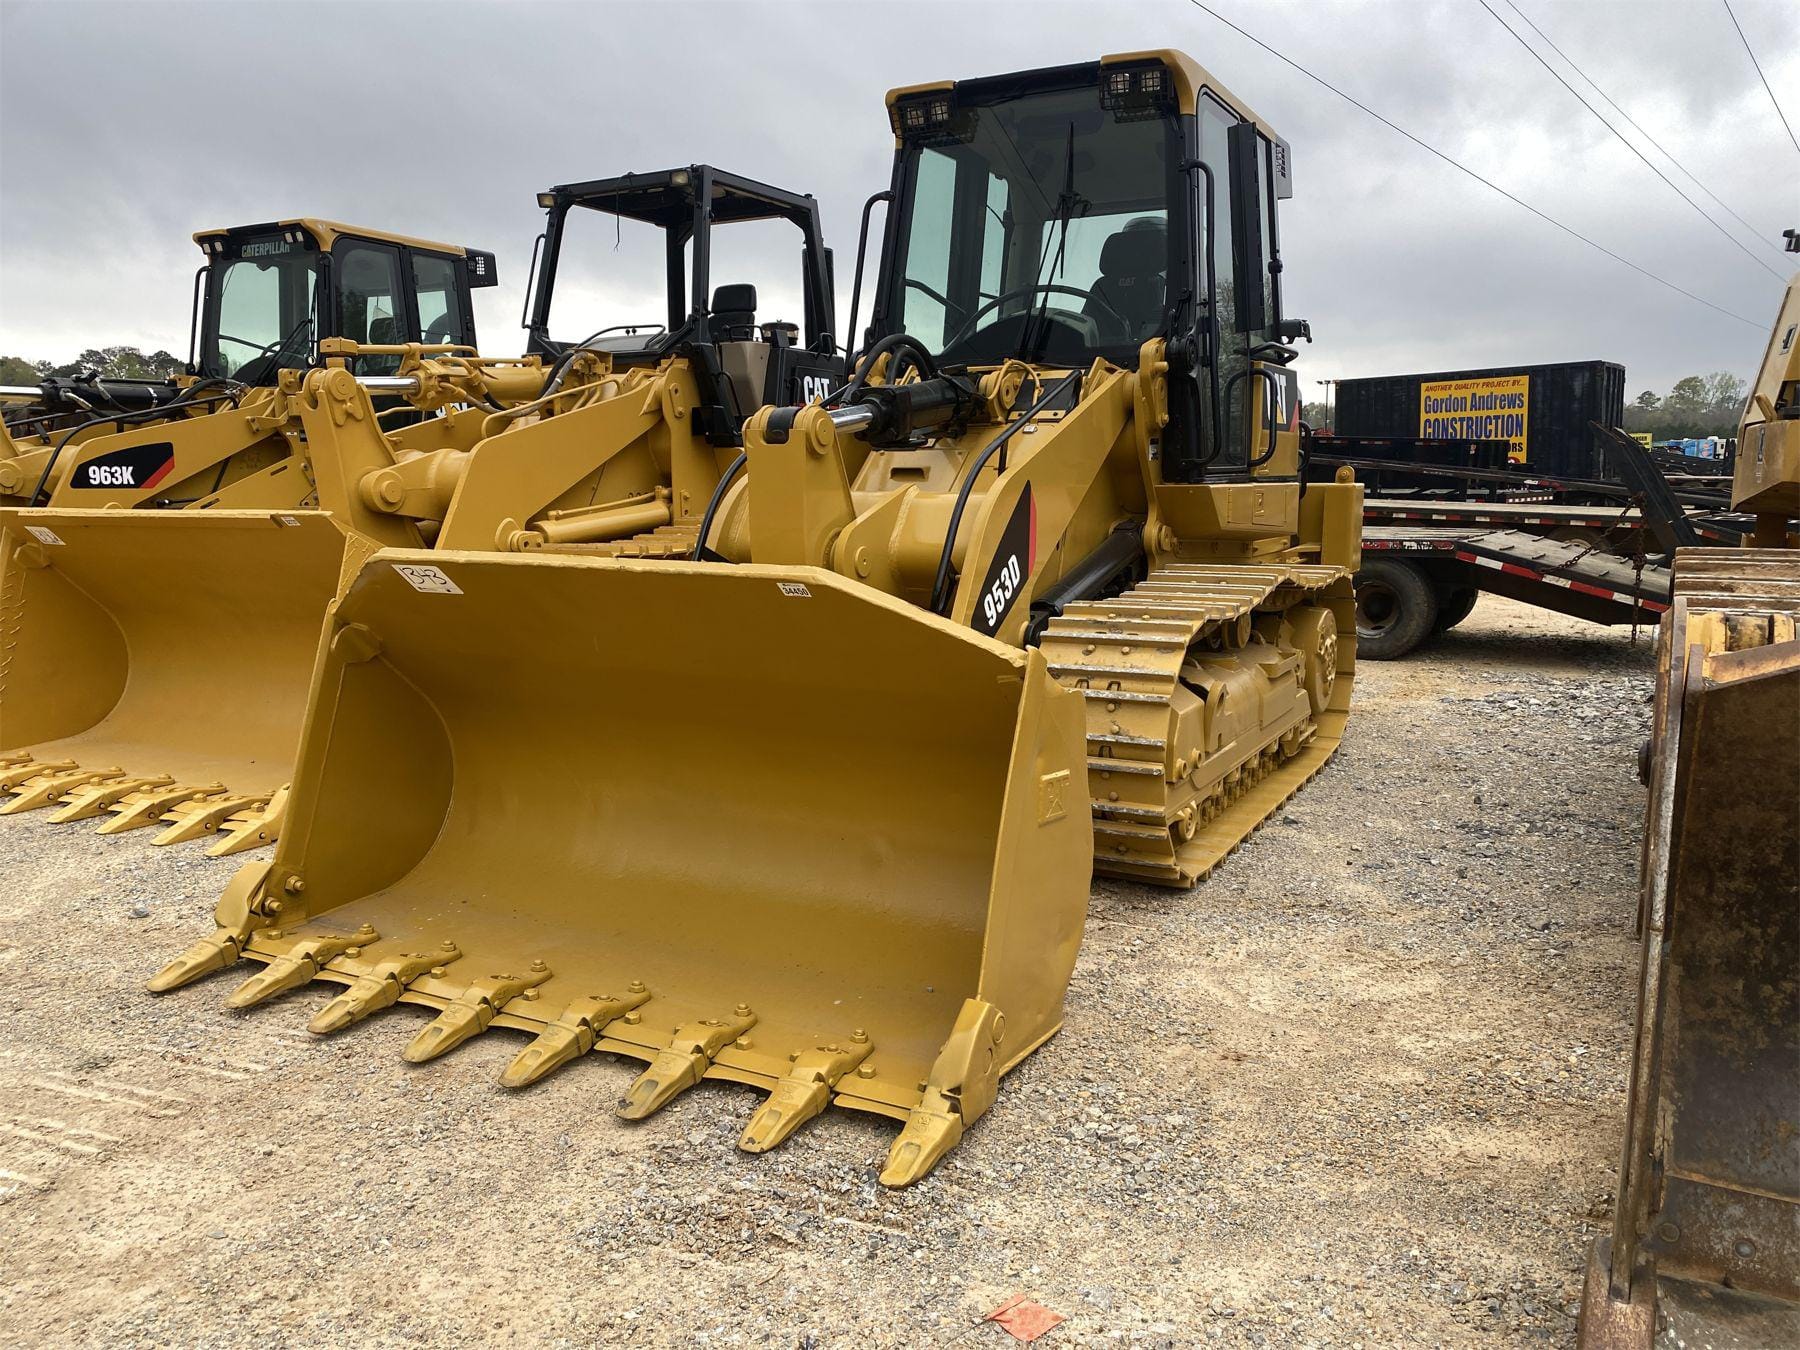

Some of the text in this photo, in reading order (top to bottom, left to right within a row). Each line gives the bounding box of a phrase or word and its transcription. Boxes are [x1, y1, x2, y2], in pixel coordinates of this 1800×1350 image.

[241, 241, 290, 257] CATERPILLAR
[804, 375, 830, 405] CAT
[1424, 384, 1453, 393] ANOTHER
[1454, 382, 1480, 391] QUALITY
[1481, 380, 1510, 389] PROJECT
[1424, 391, 1525, 415] Gordon Andrews
[1423, 413, 1524, 440] CONSTRUCTION
[88, 465, 135, 485] 963K
[983, 554, 1021, 627] 953D
